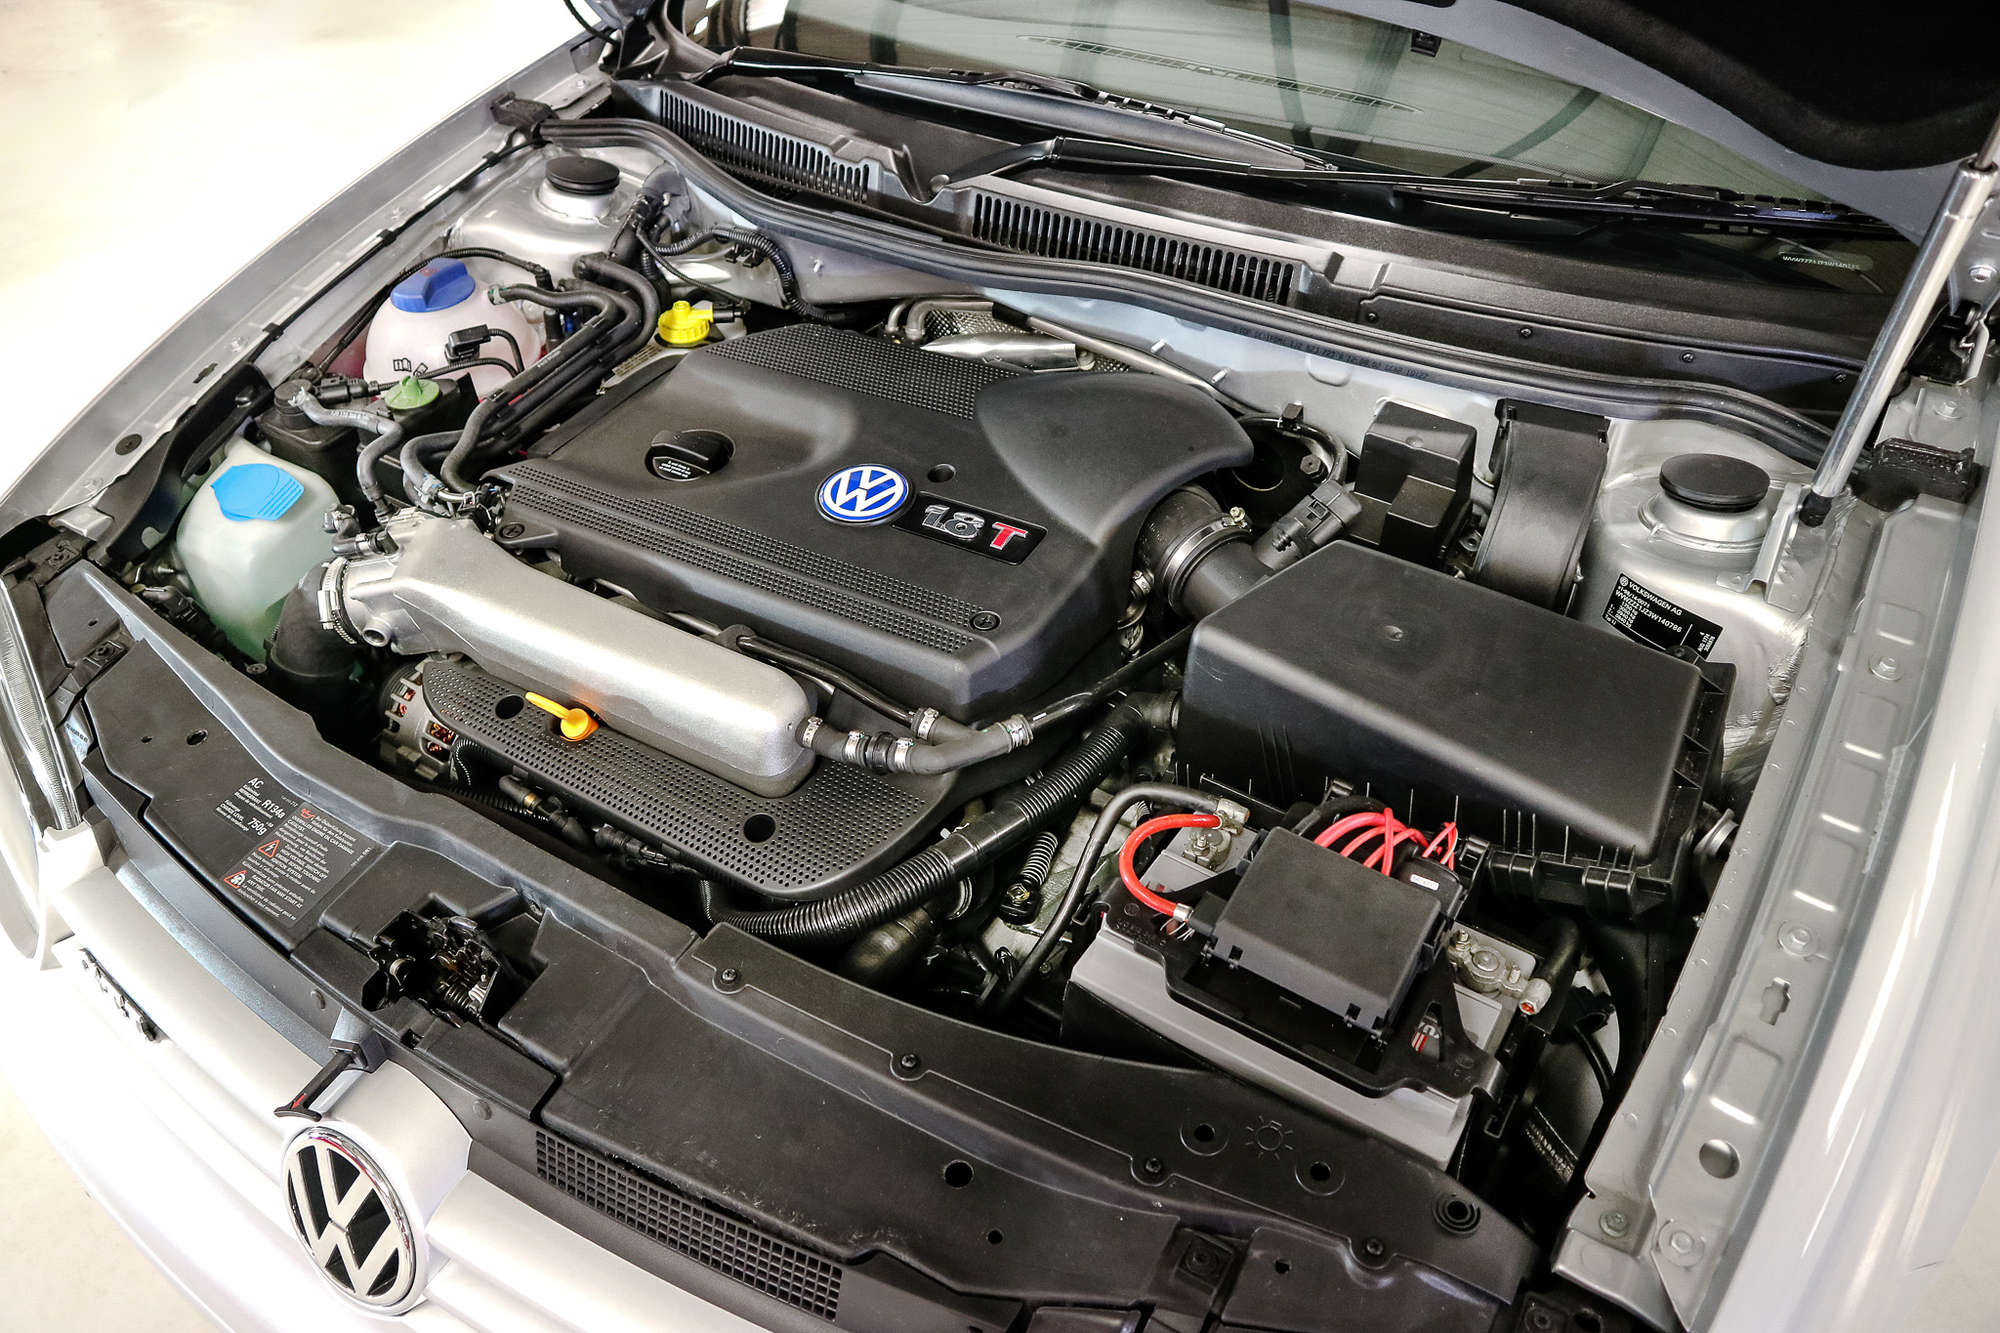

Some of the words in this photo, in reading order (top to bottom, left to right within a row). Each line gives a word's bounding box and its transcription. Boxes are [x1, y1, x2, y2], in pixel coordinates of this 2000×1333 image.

[1629, 581, 1672, 610] VOLKSWAGEN
[1670, 607, 1683, 616] AG
[247, 777, 264, 789] AC
[261, 799, 286, 819] R134a
[247, 817, 268, 836] 750g
